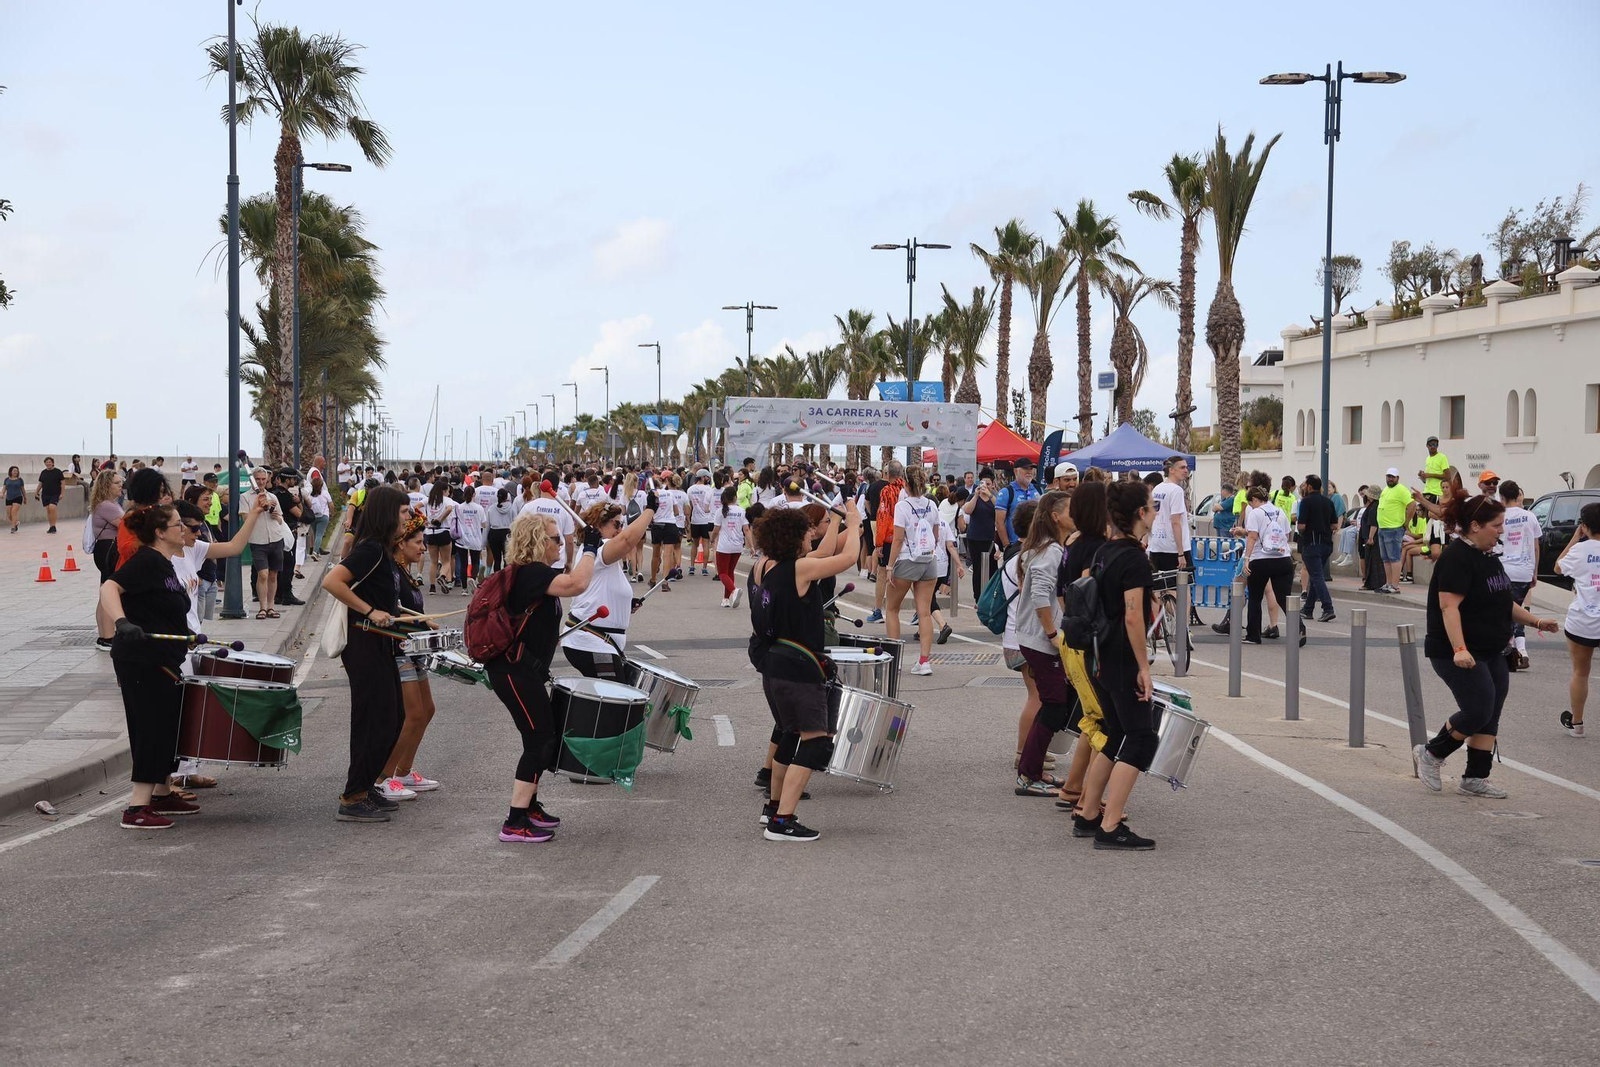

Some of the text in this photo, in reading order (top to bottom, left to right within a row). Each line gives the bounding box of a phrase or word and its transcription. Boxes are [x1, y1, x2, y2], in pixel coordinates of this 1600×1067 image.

[809, 407, 899, 418] 3A CARRERA 5K
